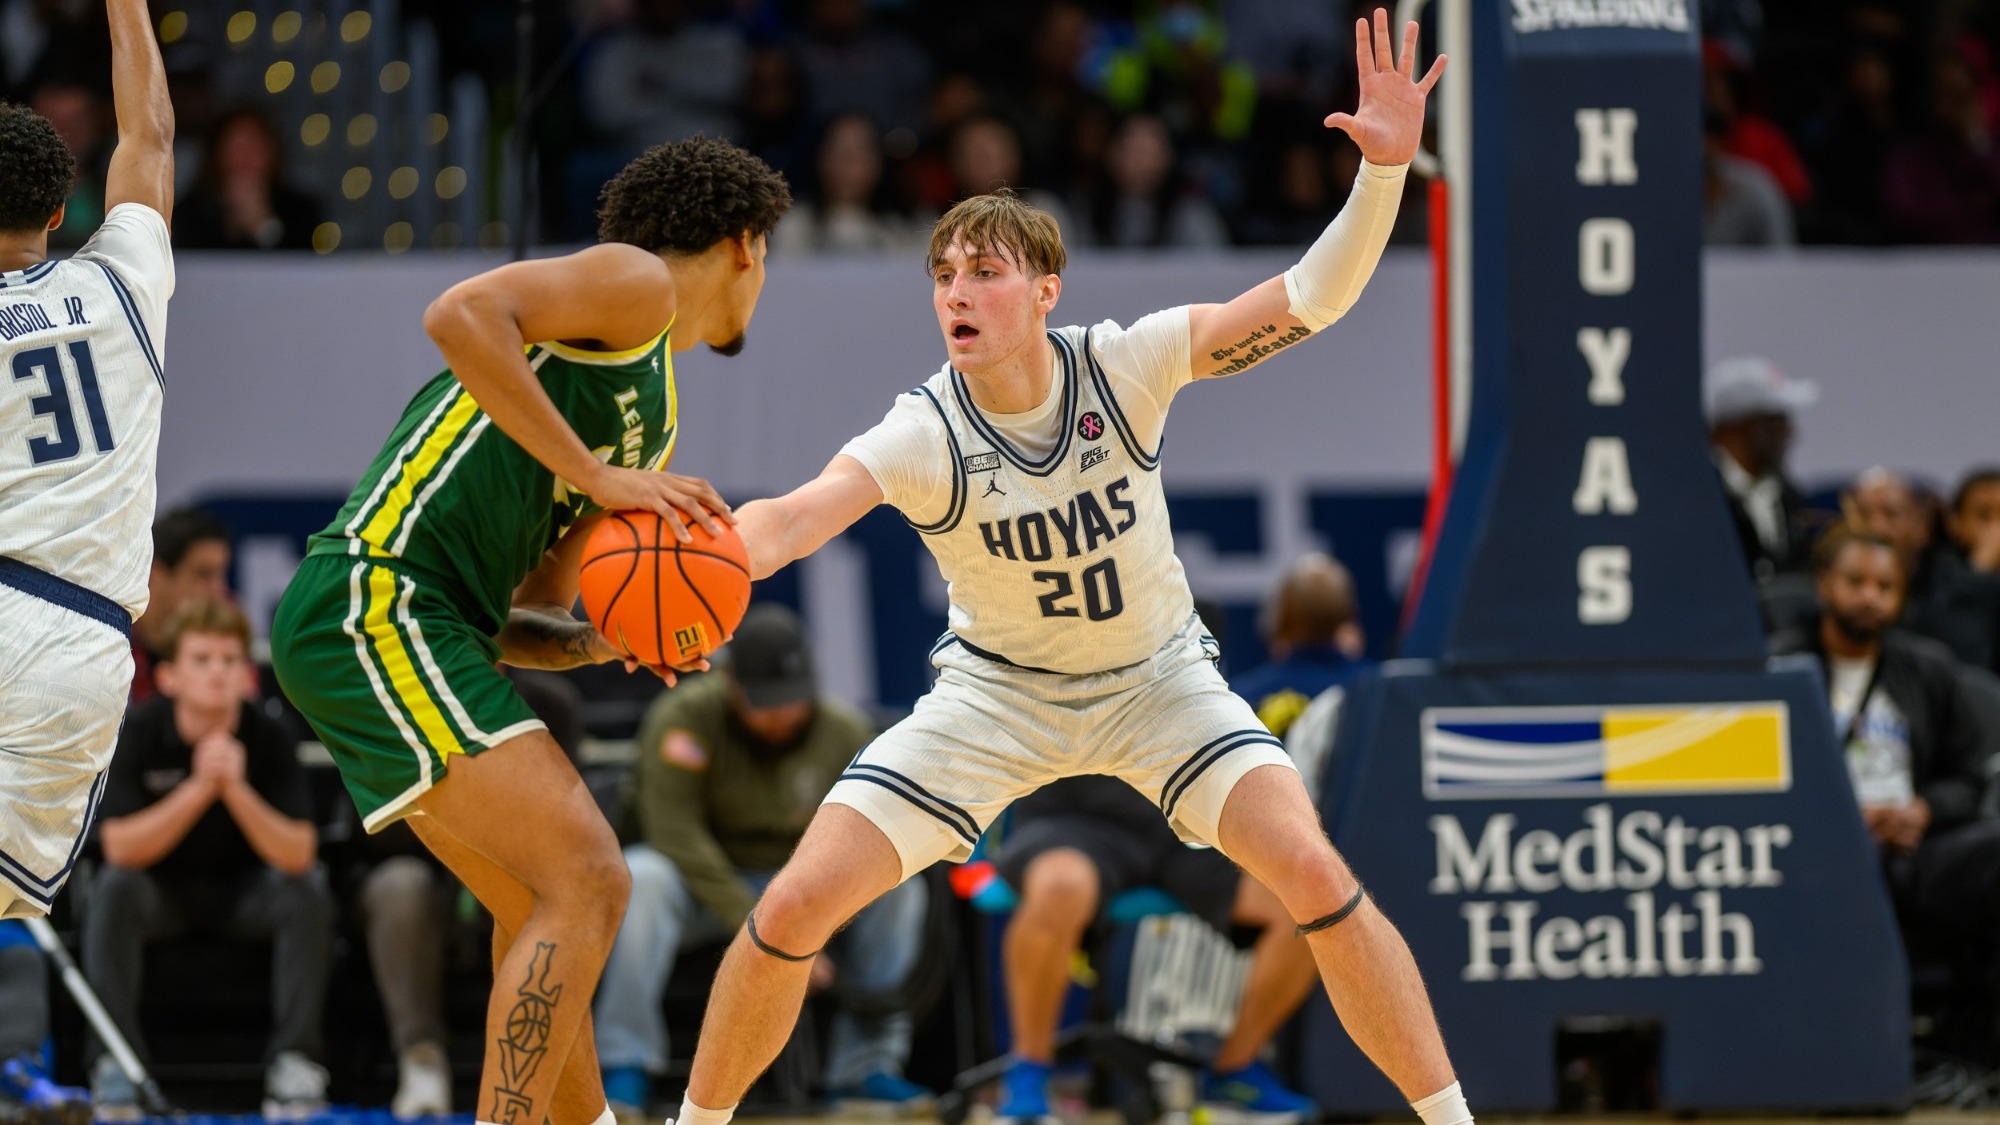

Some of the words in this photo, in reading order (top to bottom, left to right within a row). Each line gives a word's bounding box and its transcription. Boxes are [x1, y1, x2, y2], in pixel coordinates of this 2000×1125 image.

[0, 303, 57, 341] BRISTOL
[64, 296, 91, 325] JR.
[1211, 348, 1236, 361] The
[1234, 331, 1266, 349] work
[1261, 324, 1277, 334] is
[1210, 326, 1311, 376] undefeated
[1573, 108, 1639, 625] HOYAS
[10, 337, 116, 466] 31
[968, 461, 999, 472] CHANGE
[1080, 450, 1110, 469] EAST
[1081, 446, 1102, 459] BIG
[978, 475, 1137, 562] HOYAS
[1032, 557, 1124, 622] 20
[1427, 802, 1793, 894] MedStar
[1460, 890, 1764, 982] Health
